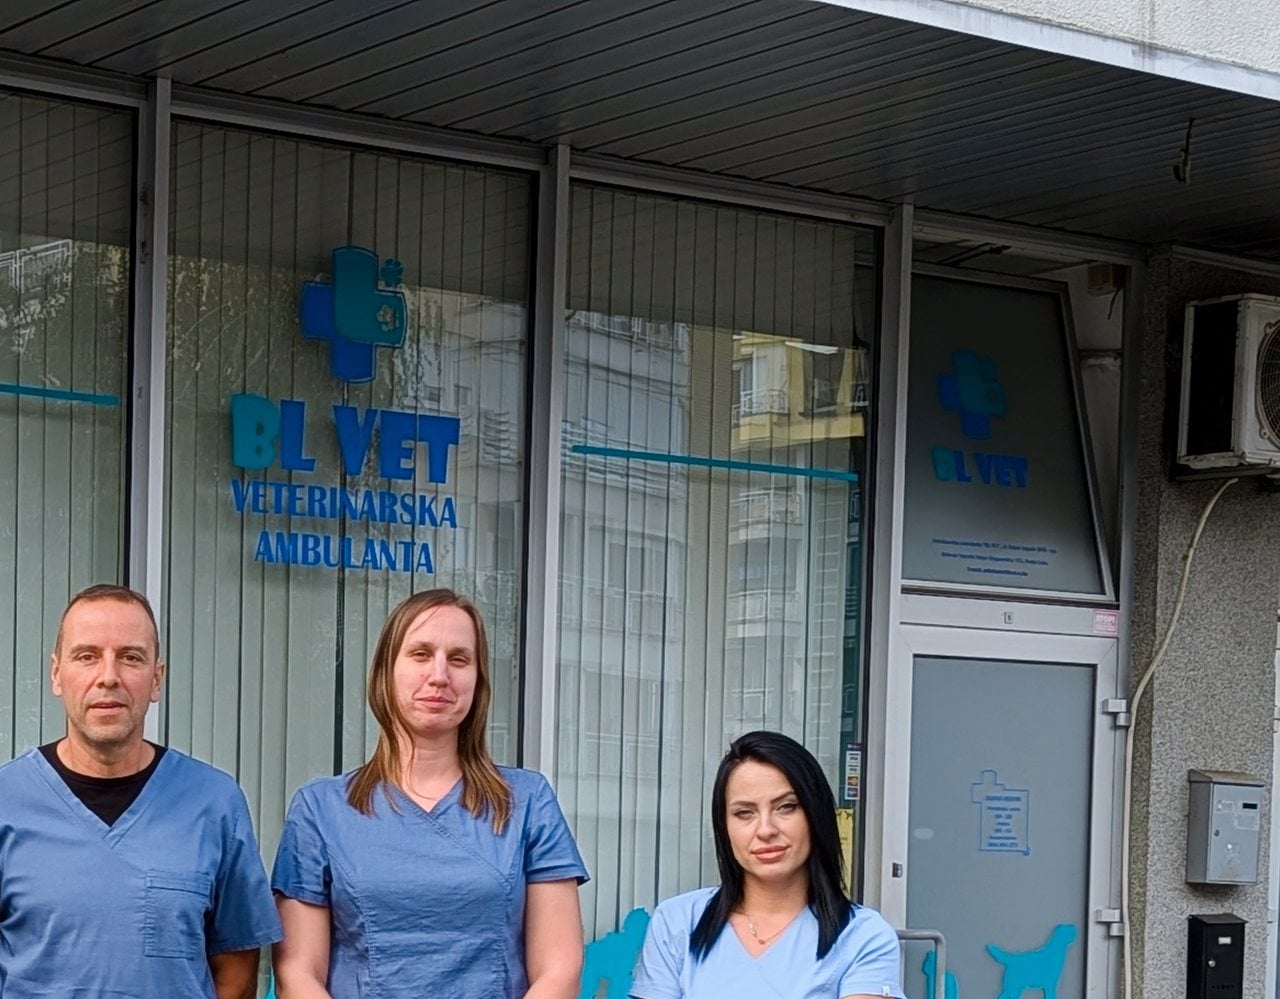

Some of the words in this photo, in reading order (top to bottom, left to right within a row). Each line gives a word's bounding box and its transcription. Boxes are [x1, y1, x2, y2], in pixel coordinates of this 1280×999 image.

[230, 393, 317, 472] BL
[332, 405, 461, 484] VET
[974, 452, 1028, 488] VET
[231, 478, 458, 529] VETERINARSKA
[254, 530, 435, 574] AMBULANTA
